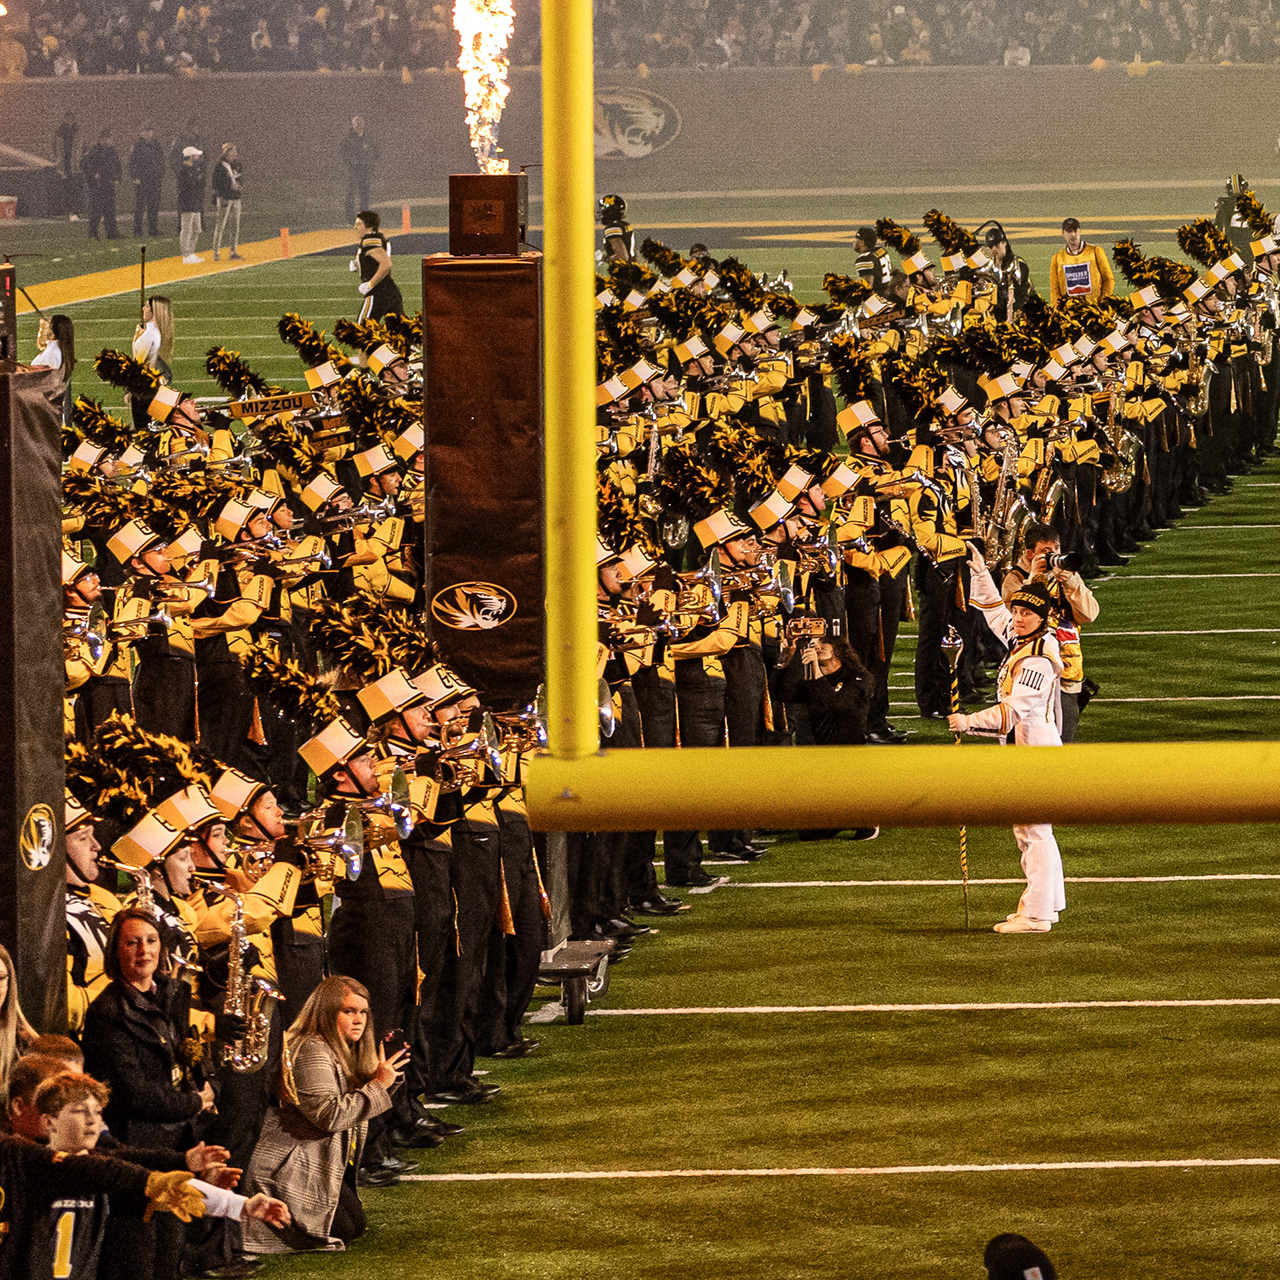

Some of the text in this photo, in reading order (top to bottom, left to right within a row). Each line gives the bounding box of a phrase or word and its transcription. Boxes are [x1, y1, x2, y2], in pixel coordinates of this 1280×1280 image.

[241, 397, 303, 414] MIZZOU
[278, 869, 293, 905] MIZZOU
[53, 1211, 75, 1278] 1
